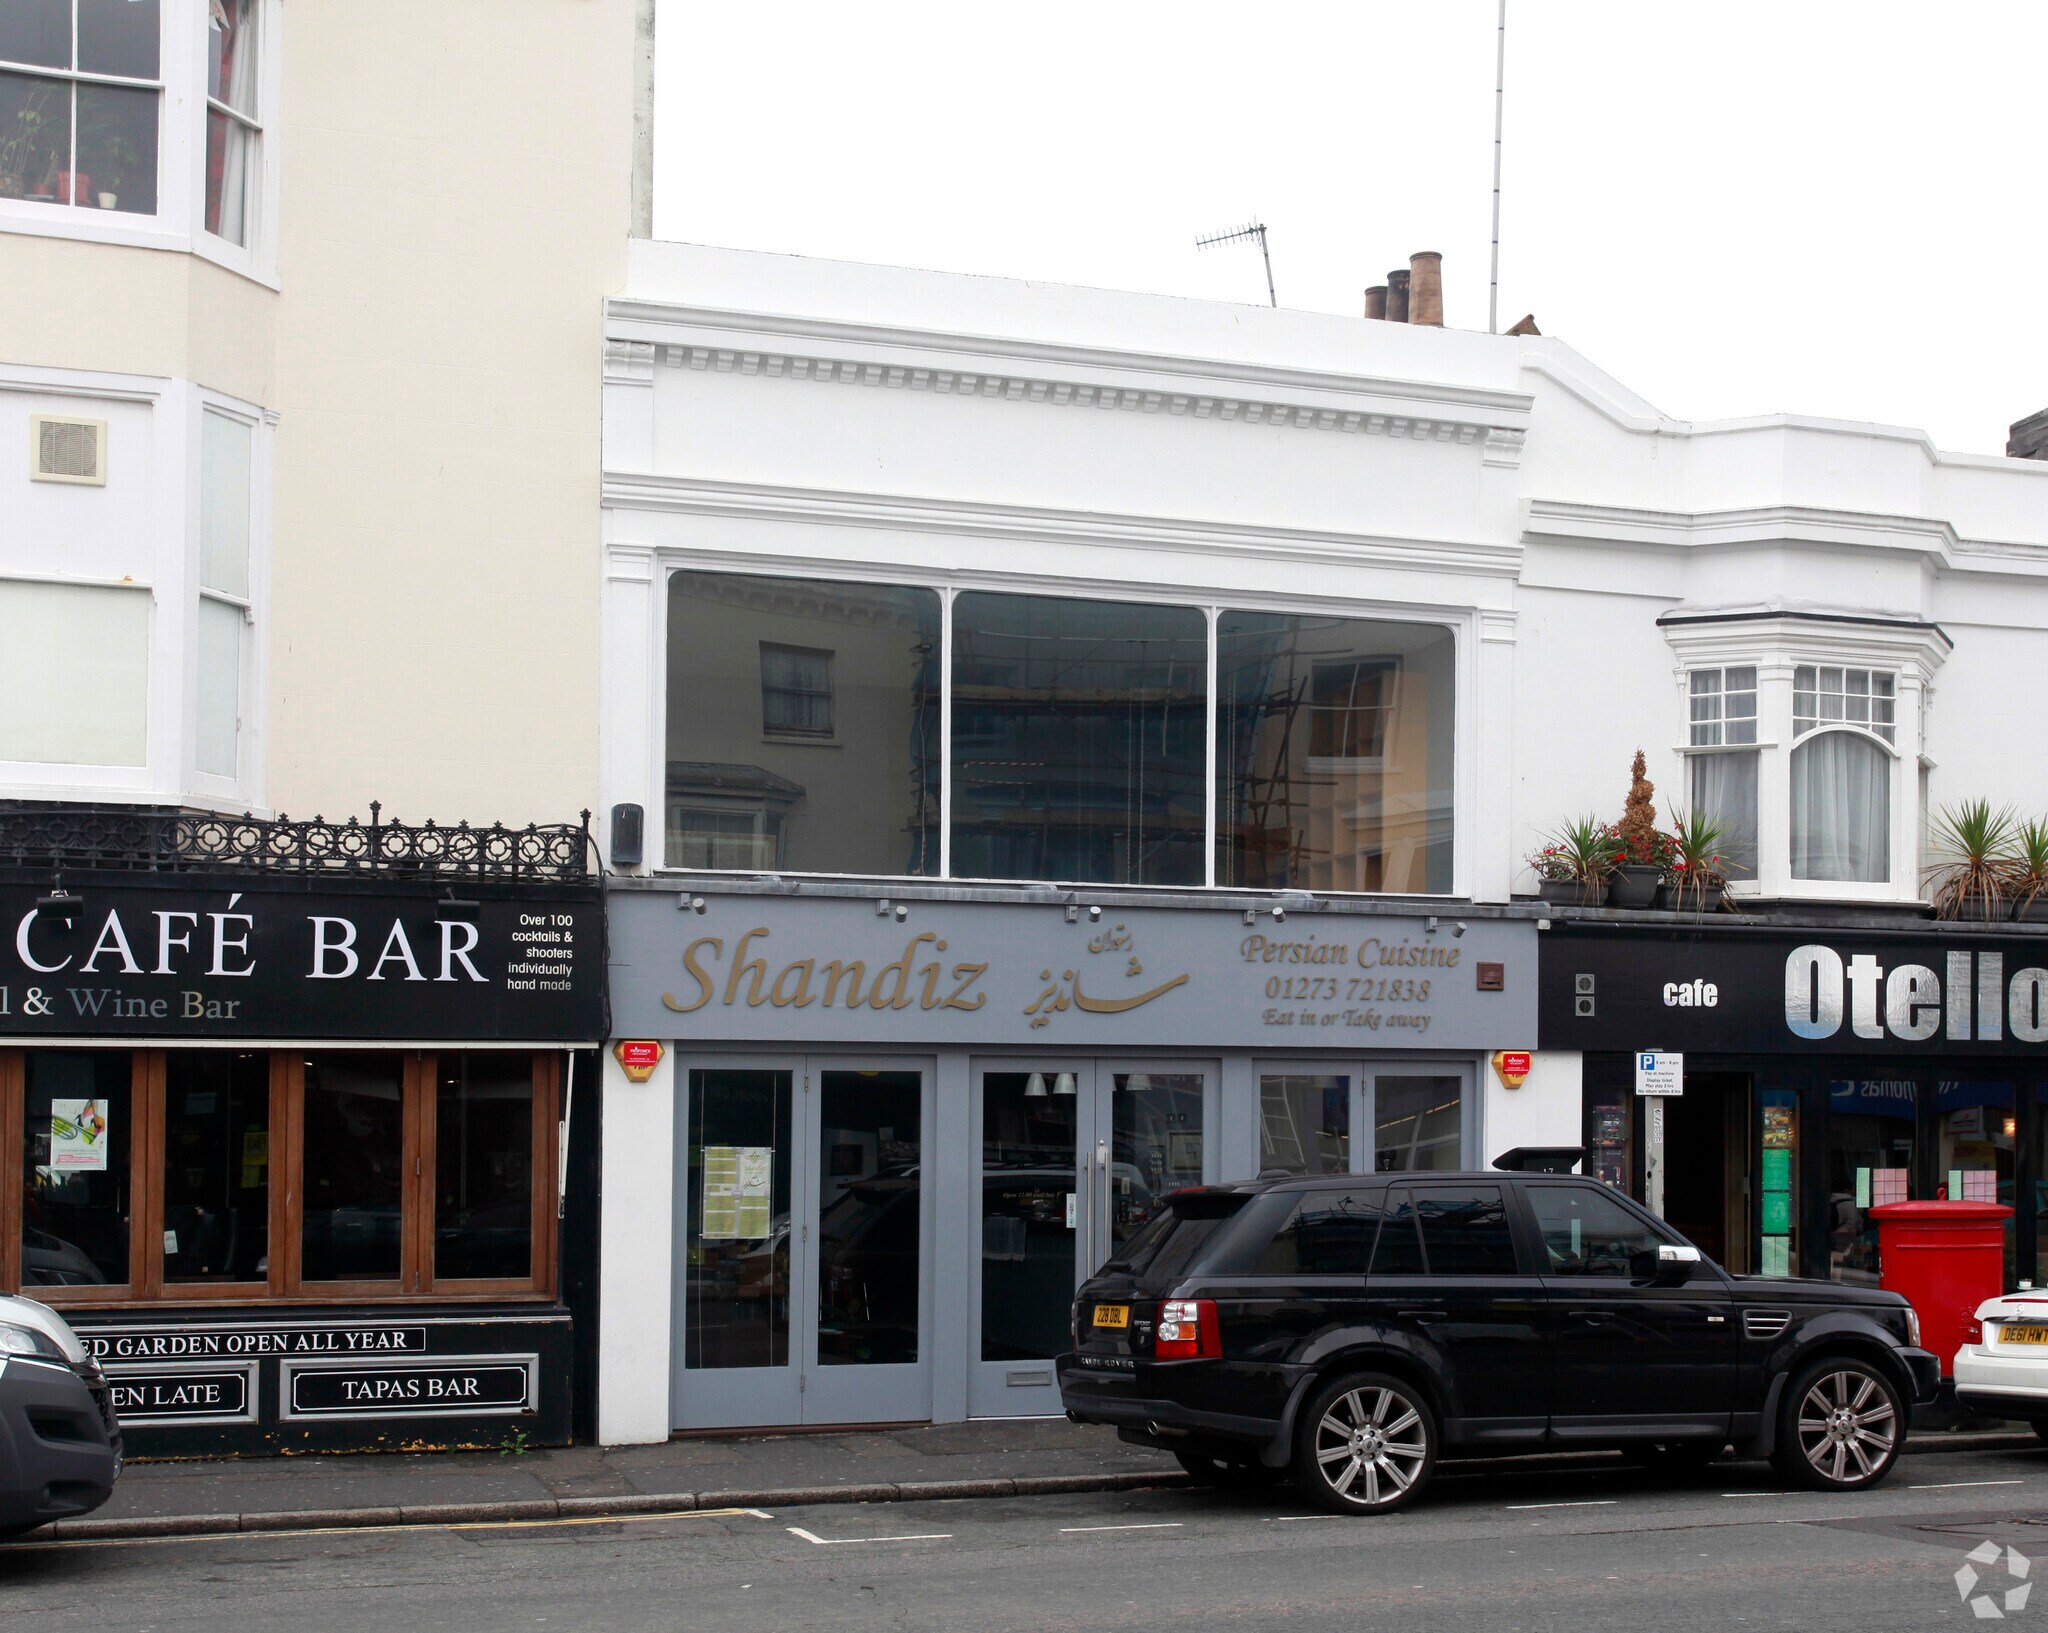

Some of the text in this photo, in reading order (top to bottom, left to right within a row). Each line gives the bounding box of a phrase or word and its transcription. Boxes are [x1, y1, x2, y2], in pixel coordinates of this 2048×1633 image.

[519, 914, 573, 926] Over 100
[16, 893, 489, 982] CAFÉ BAR
[512, 930, 573, 942] cocktails &
[526, 946, 573, 959] shooters
[1240, 934, 1462, 969] Persian Cuisine
[508, 962, 572, 977] individually
[662, 927, 989, 1012] Shandiz
[507, 978, 572, 990] hand made
[1265, 975, 1431, 1001] 01273 721838
[1663, 979, 1718, 1007] cafe
[1784, 944, 2048, 1042] Otello
[23, 986, 54, 1016] &
[65, 987, 168, 1019] Wine
[180, 991, 240, 1021] Bar
[1262, 1008, 1431, 1032] Eat in or Take away
[1643, 1055, 1653, 1070] P
[84, 1331, 407, 1356] ED GARDEN OPEN ALL YEAR
[111, 1384, 220, 1406] EN LATE
[342, 1377, 480, 1399] TAPAS BAR
